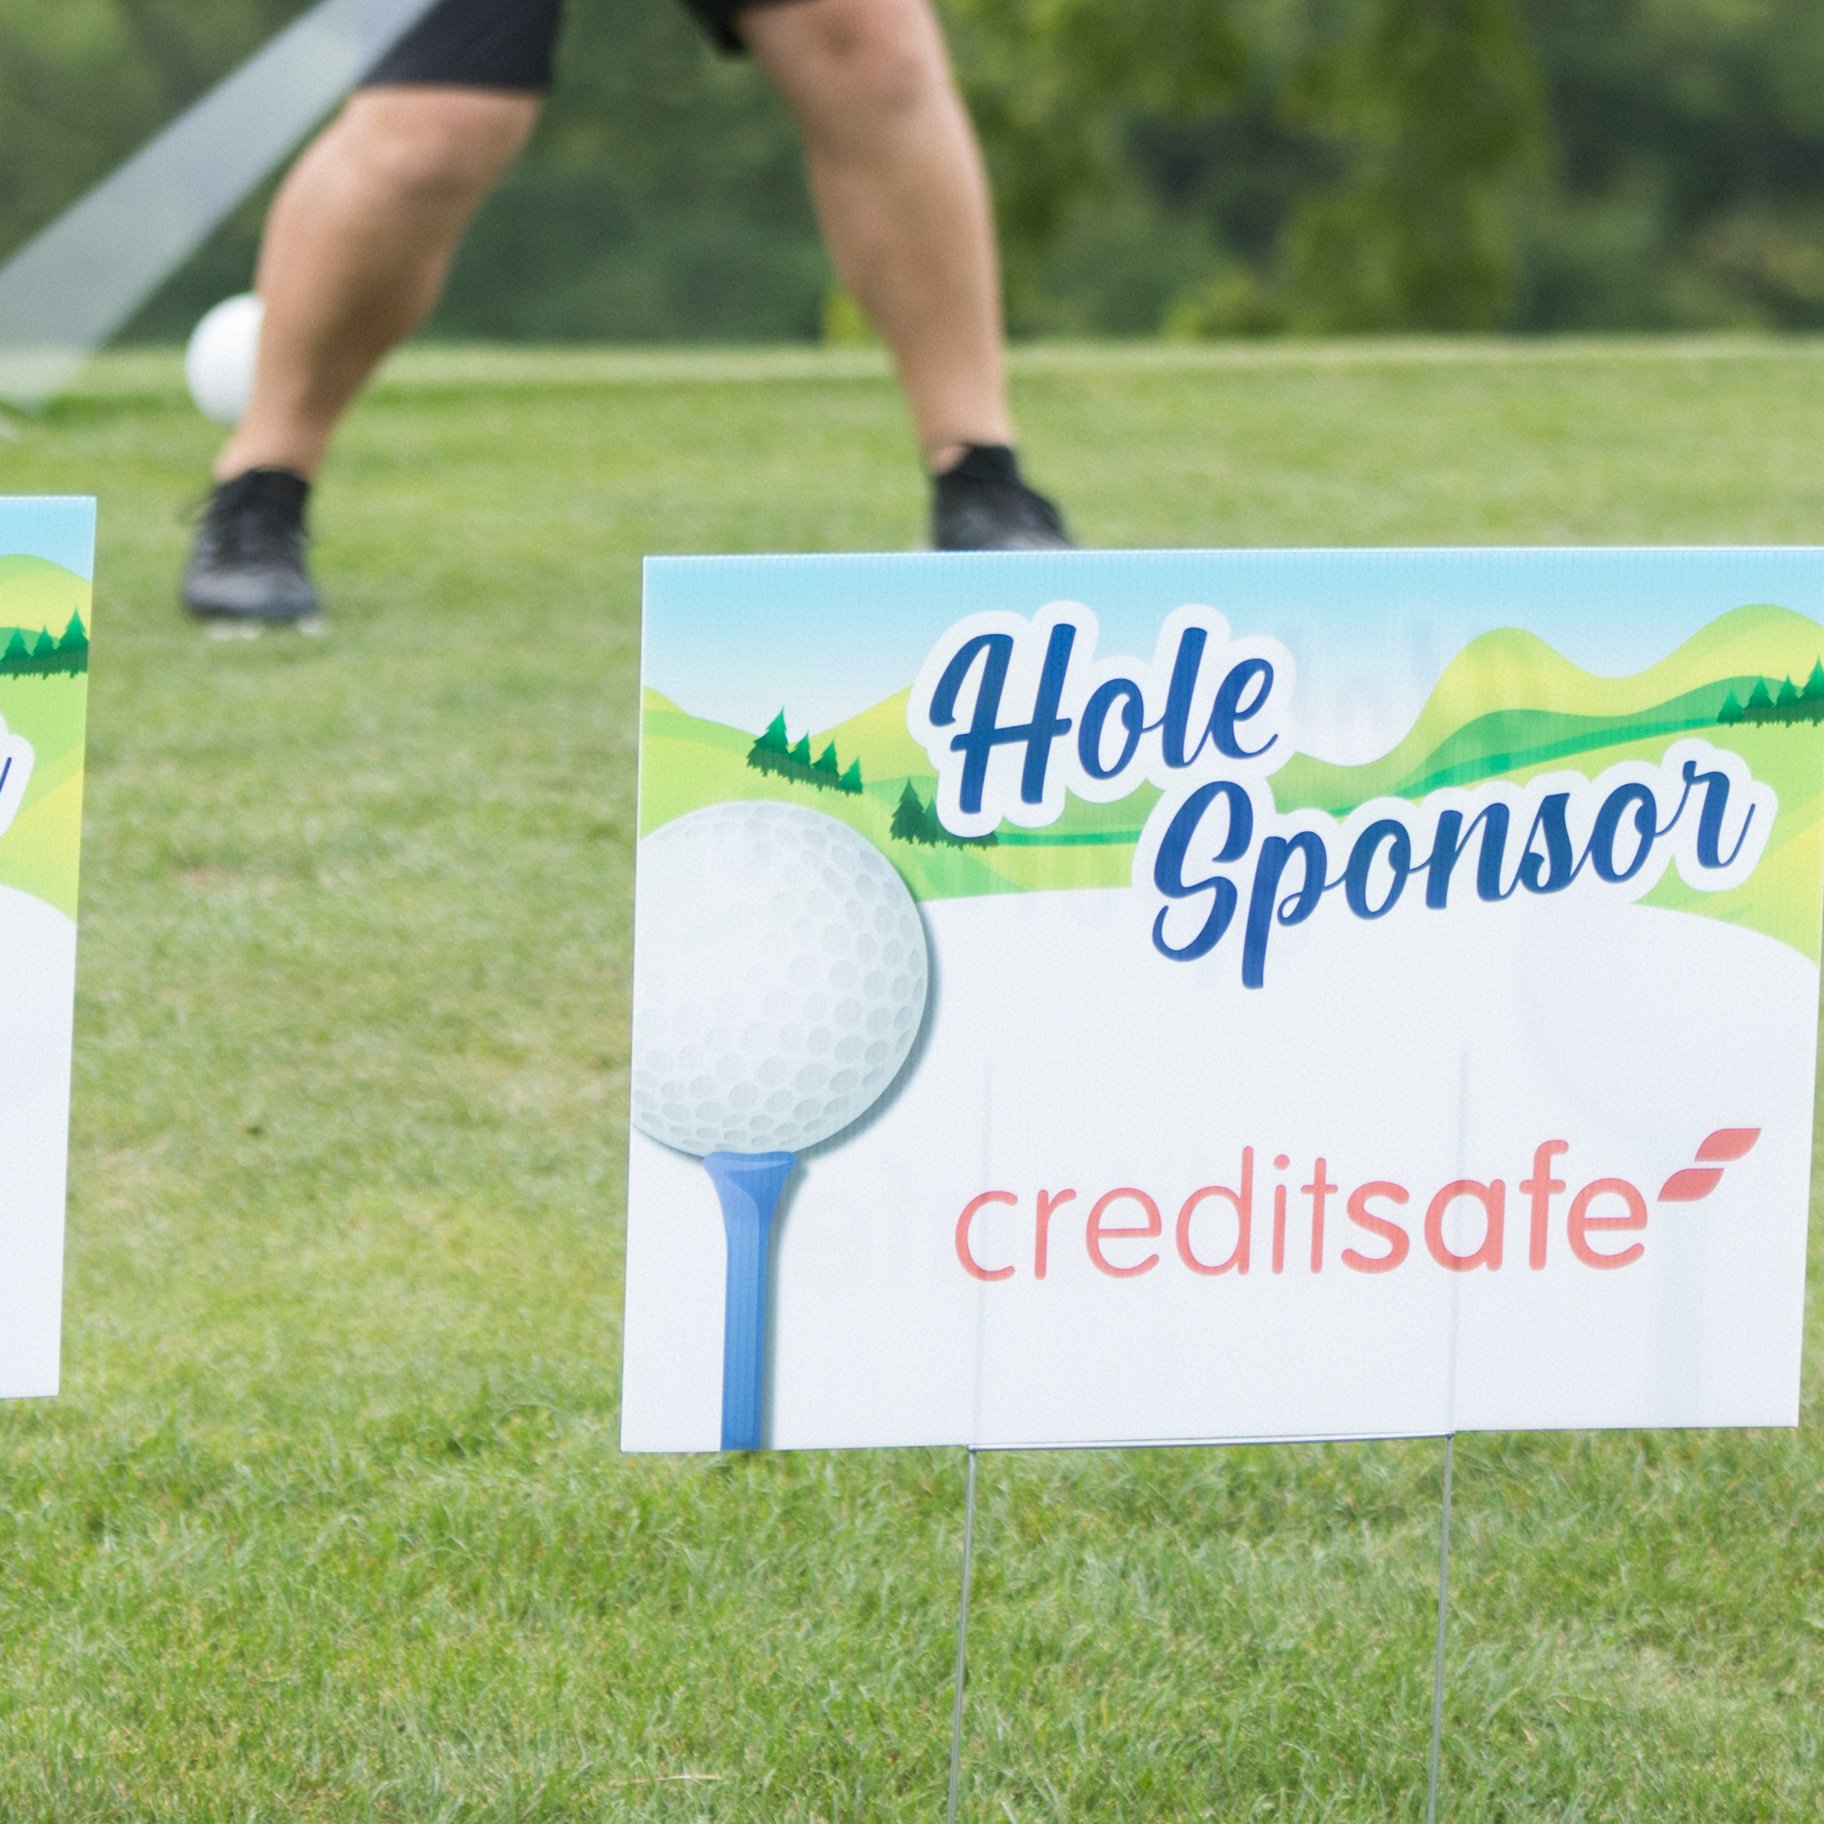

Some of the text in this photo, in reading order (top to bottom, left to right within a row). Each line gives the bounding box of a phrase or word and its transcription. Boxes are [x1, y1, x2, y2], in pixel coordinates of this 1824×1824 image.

[927, 621, 1280, 816] Hole
[1150, 758, 1758, 990] Sponsor
[952, 1137, 1651, 1283] creditsafe
